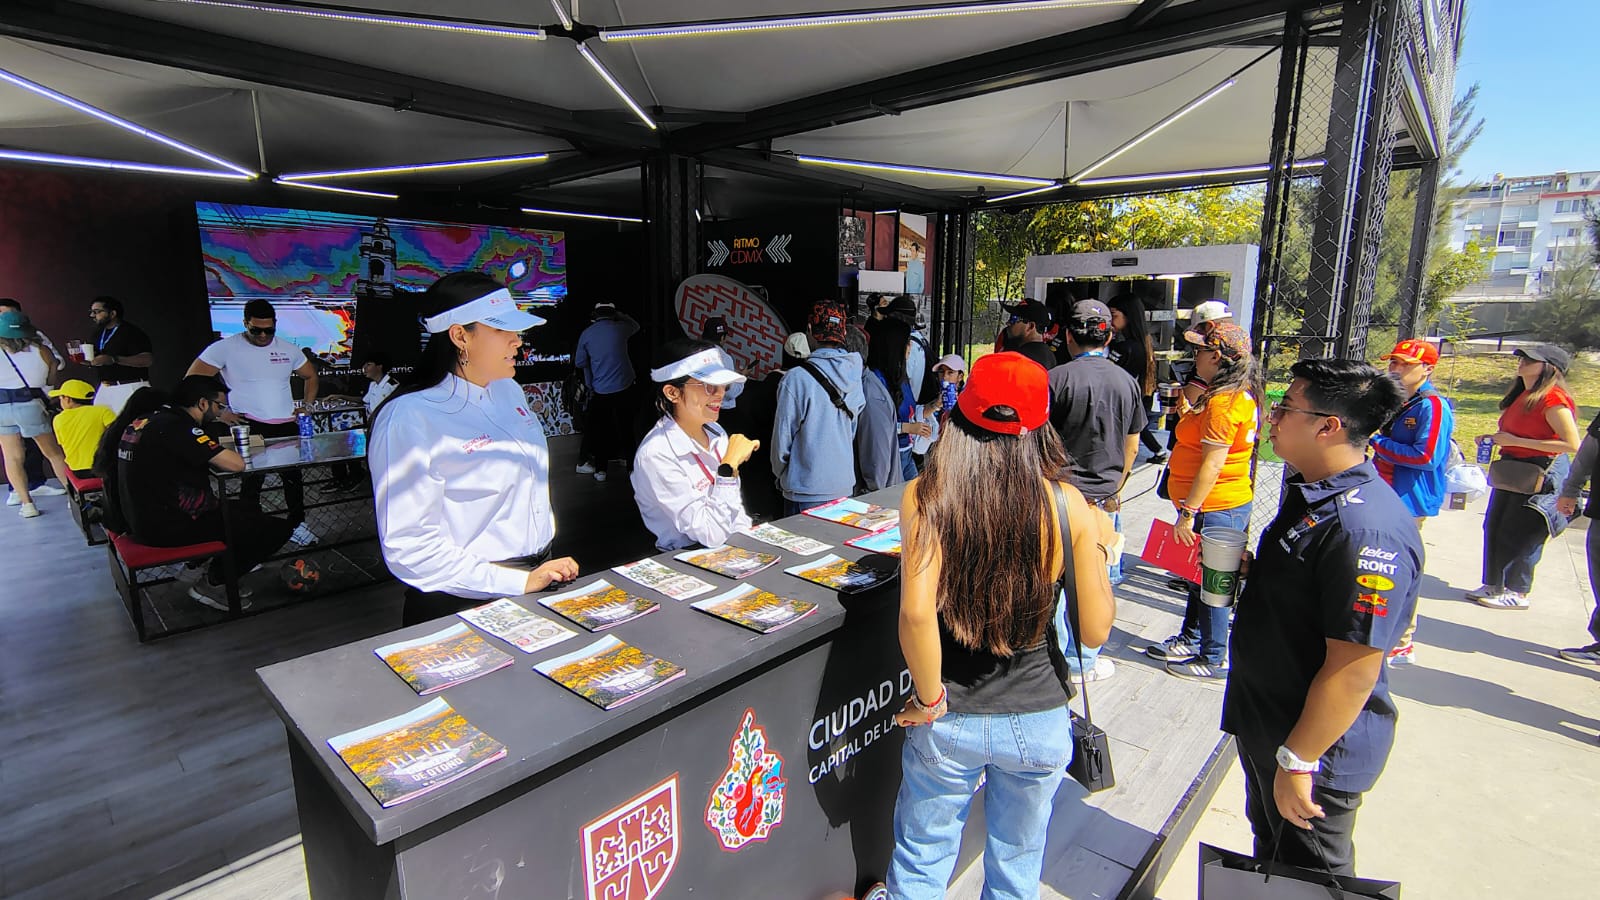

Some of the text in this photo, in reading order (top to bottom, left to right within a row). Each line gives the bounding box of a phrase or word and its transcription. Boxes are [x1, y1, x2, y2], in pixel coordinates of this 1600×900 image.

[733, 237, 760, 249] RITMO
[730, 249, 764, 264] CDMX
[1359, 545, 1398, 561] telcel
[1357, 558, 1398, 576] ROKT
[808, 680, 894, 750] CIUDAD
[808, 714, 898, 784] CAPITAL DE LA
